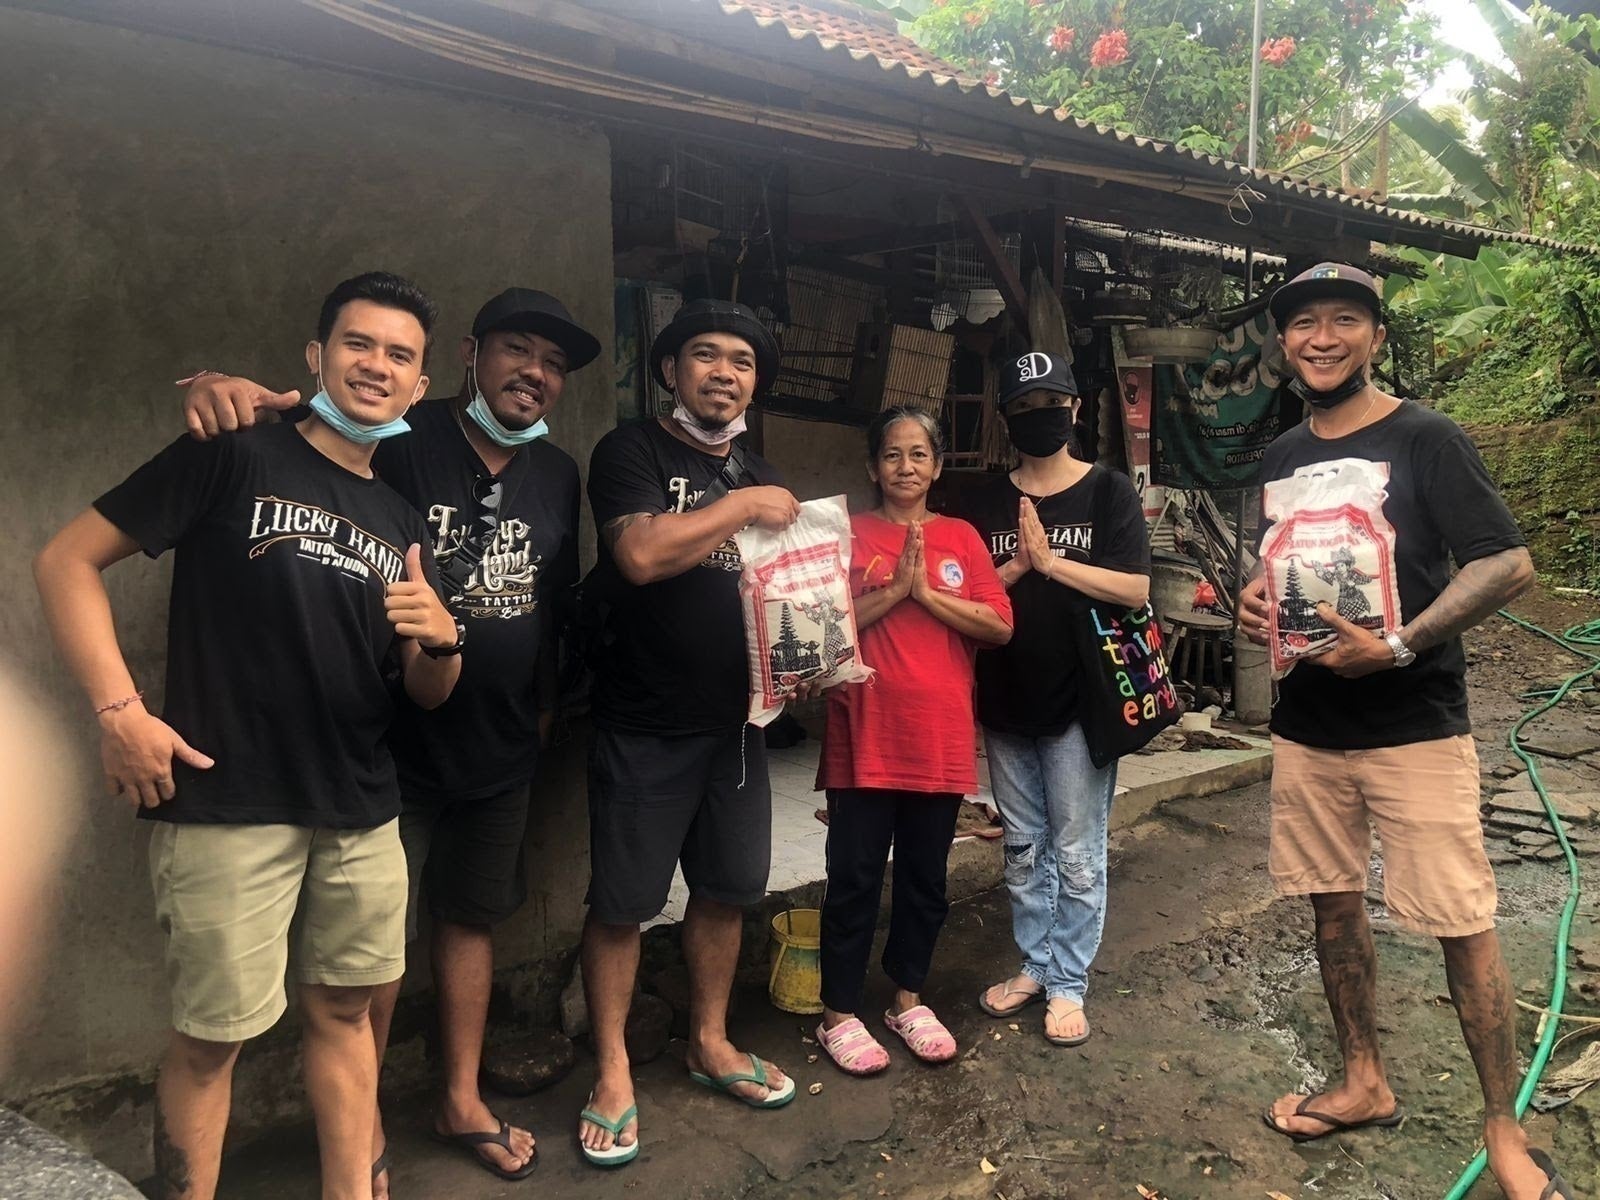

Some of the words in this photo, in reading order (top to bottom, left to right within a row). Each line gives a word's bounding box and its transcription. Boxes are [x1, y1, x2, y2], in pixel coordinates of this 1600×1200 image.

[1016, 352, 1053, 382] D
[249, 501, 339, 539] LUCKY
[348, 527, 403, 584] HAND
